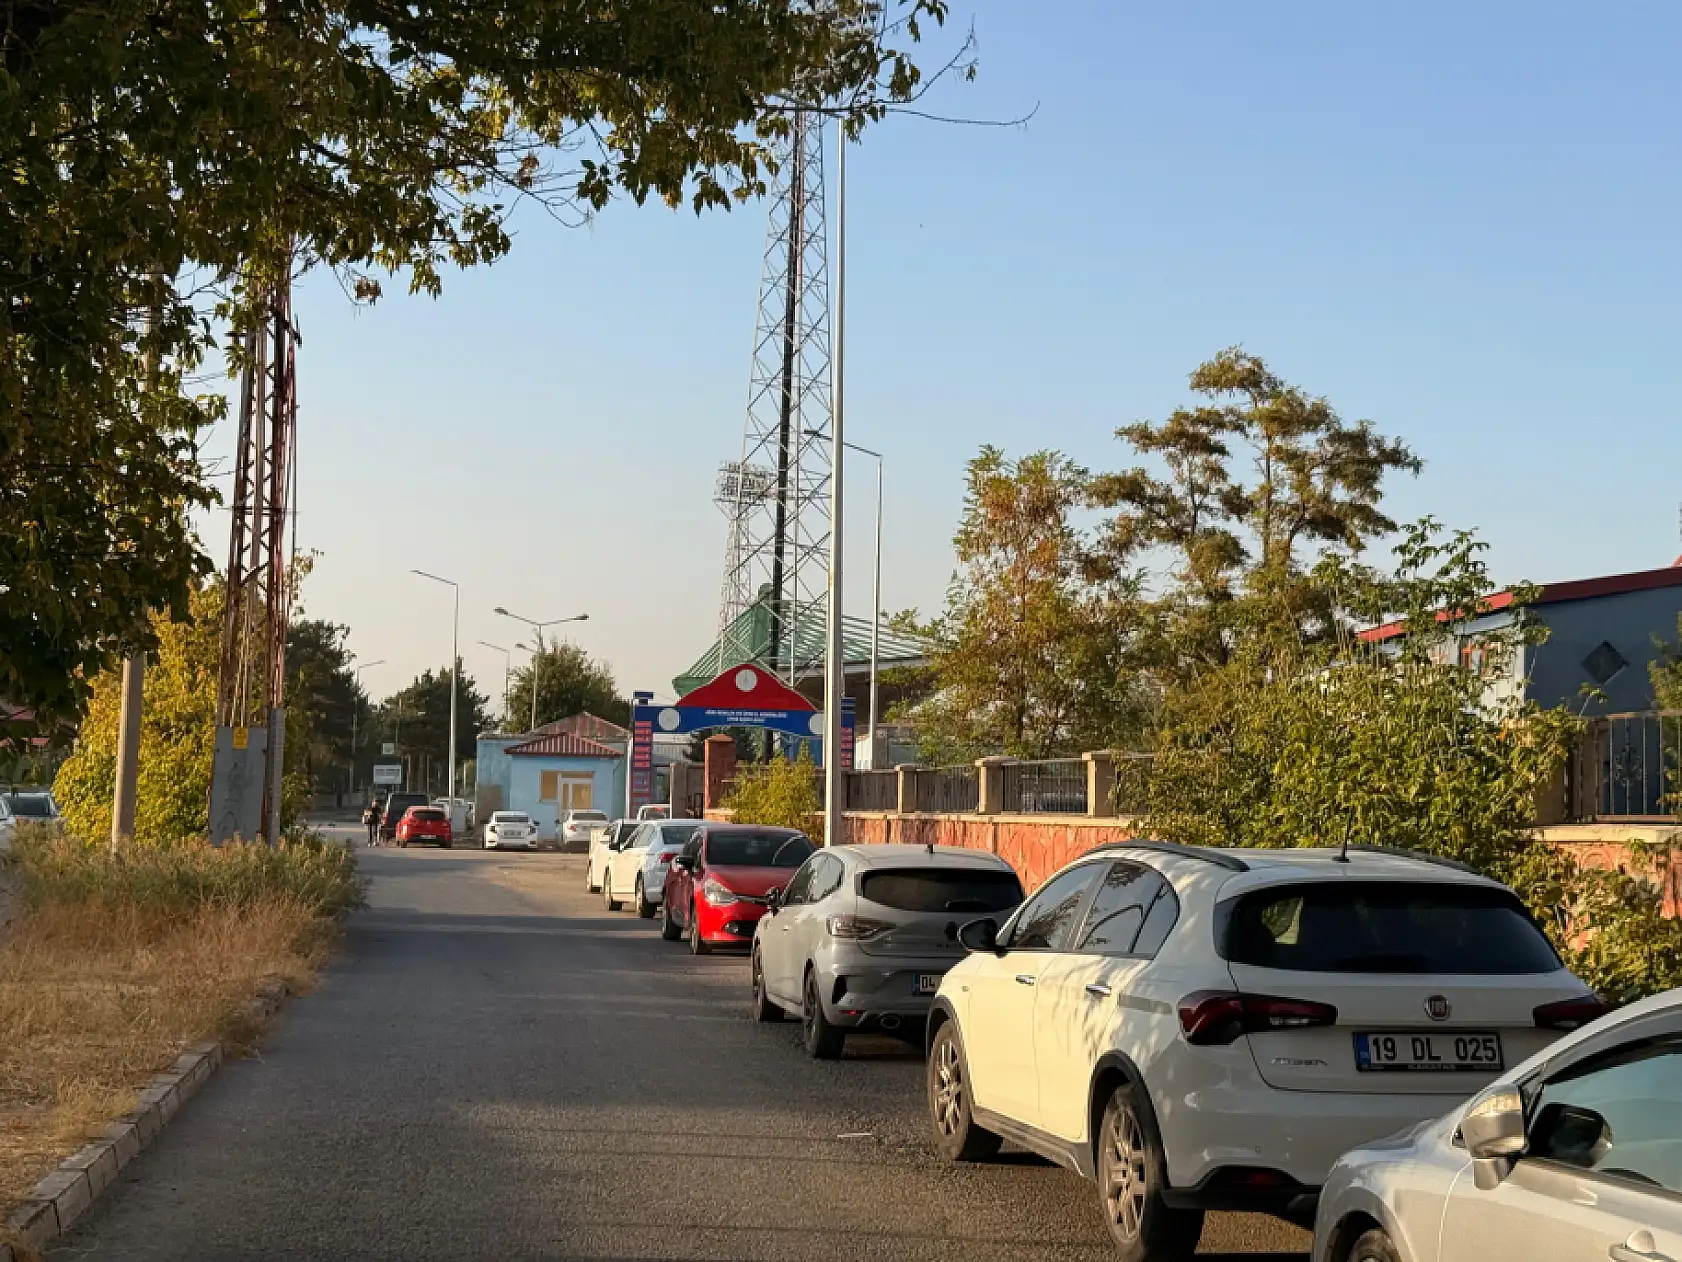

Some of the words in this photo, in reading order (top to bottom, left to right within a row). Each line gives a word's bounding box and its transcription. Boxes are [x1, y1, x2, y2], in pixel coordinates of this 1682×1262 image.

[1372, 1037, 1396, 1061] 19
[1411, 1037, 1442, 1061] DL
[1455, 1037, 1496, 1061] 025
